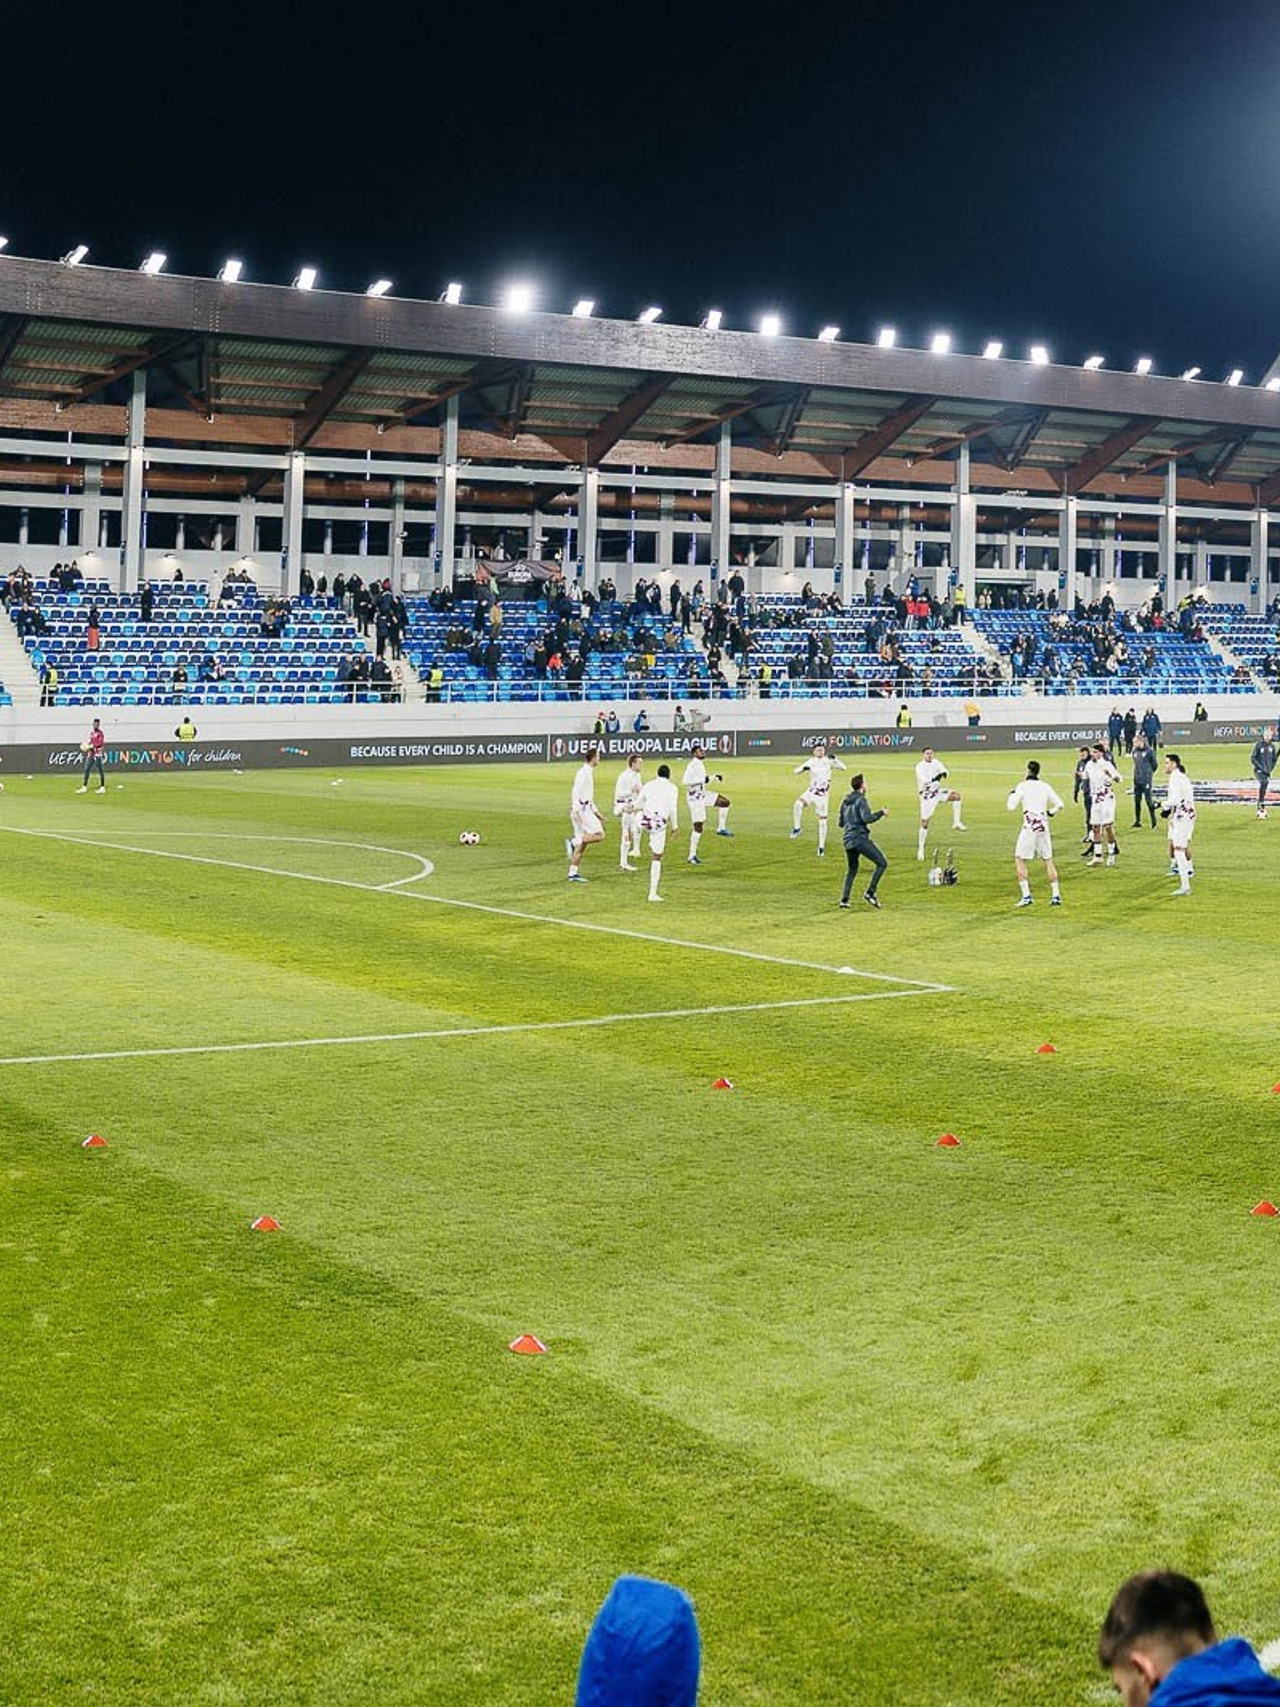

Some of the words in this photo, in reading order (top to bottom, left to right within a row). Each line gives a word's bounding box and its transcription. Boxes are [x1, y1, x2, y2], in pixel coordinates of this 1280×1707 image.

[802, 735, 828, 747] UEFA
[829, 734, 899, 747] FOUNDATION
[1014, 731, 1047, 742] BECAUSE
[1049, 731, 1070, 741] EVERY
[1072, 730, 1094, 740] CHILD
[1096, 730, 1103, 739] IS
[350, 746, 396, 758] BECAUSE
[399, 745, 431, 757] EVERY
[433, 744, 463, 756] CHILD
[465, 744, 475, 755] IS
[478, 744, 485, 755] A
[487, 742, 543, 755] CHAMPION
[568, 738, 606, 753] UEFA
[609, 738, 663, 752] EUROPA
[666, 737, 717, 751] LEAGUE
[49, 752, 83, 765] UEFA
[187, 749, 202, 766] for
[204, 749, 241, 762] children
